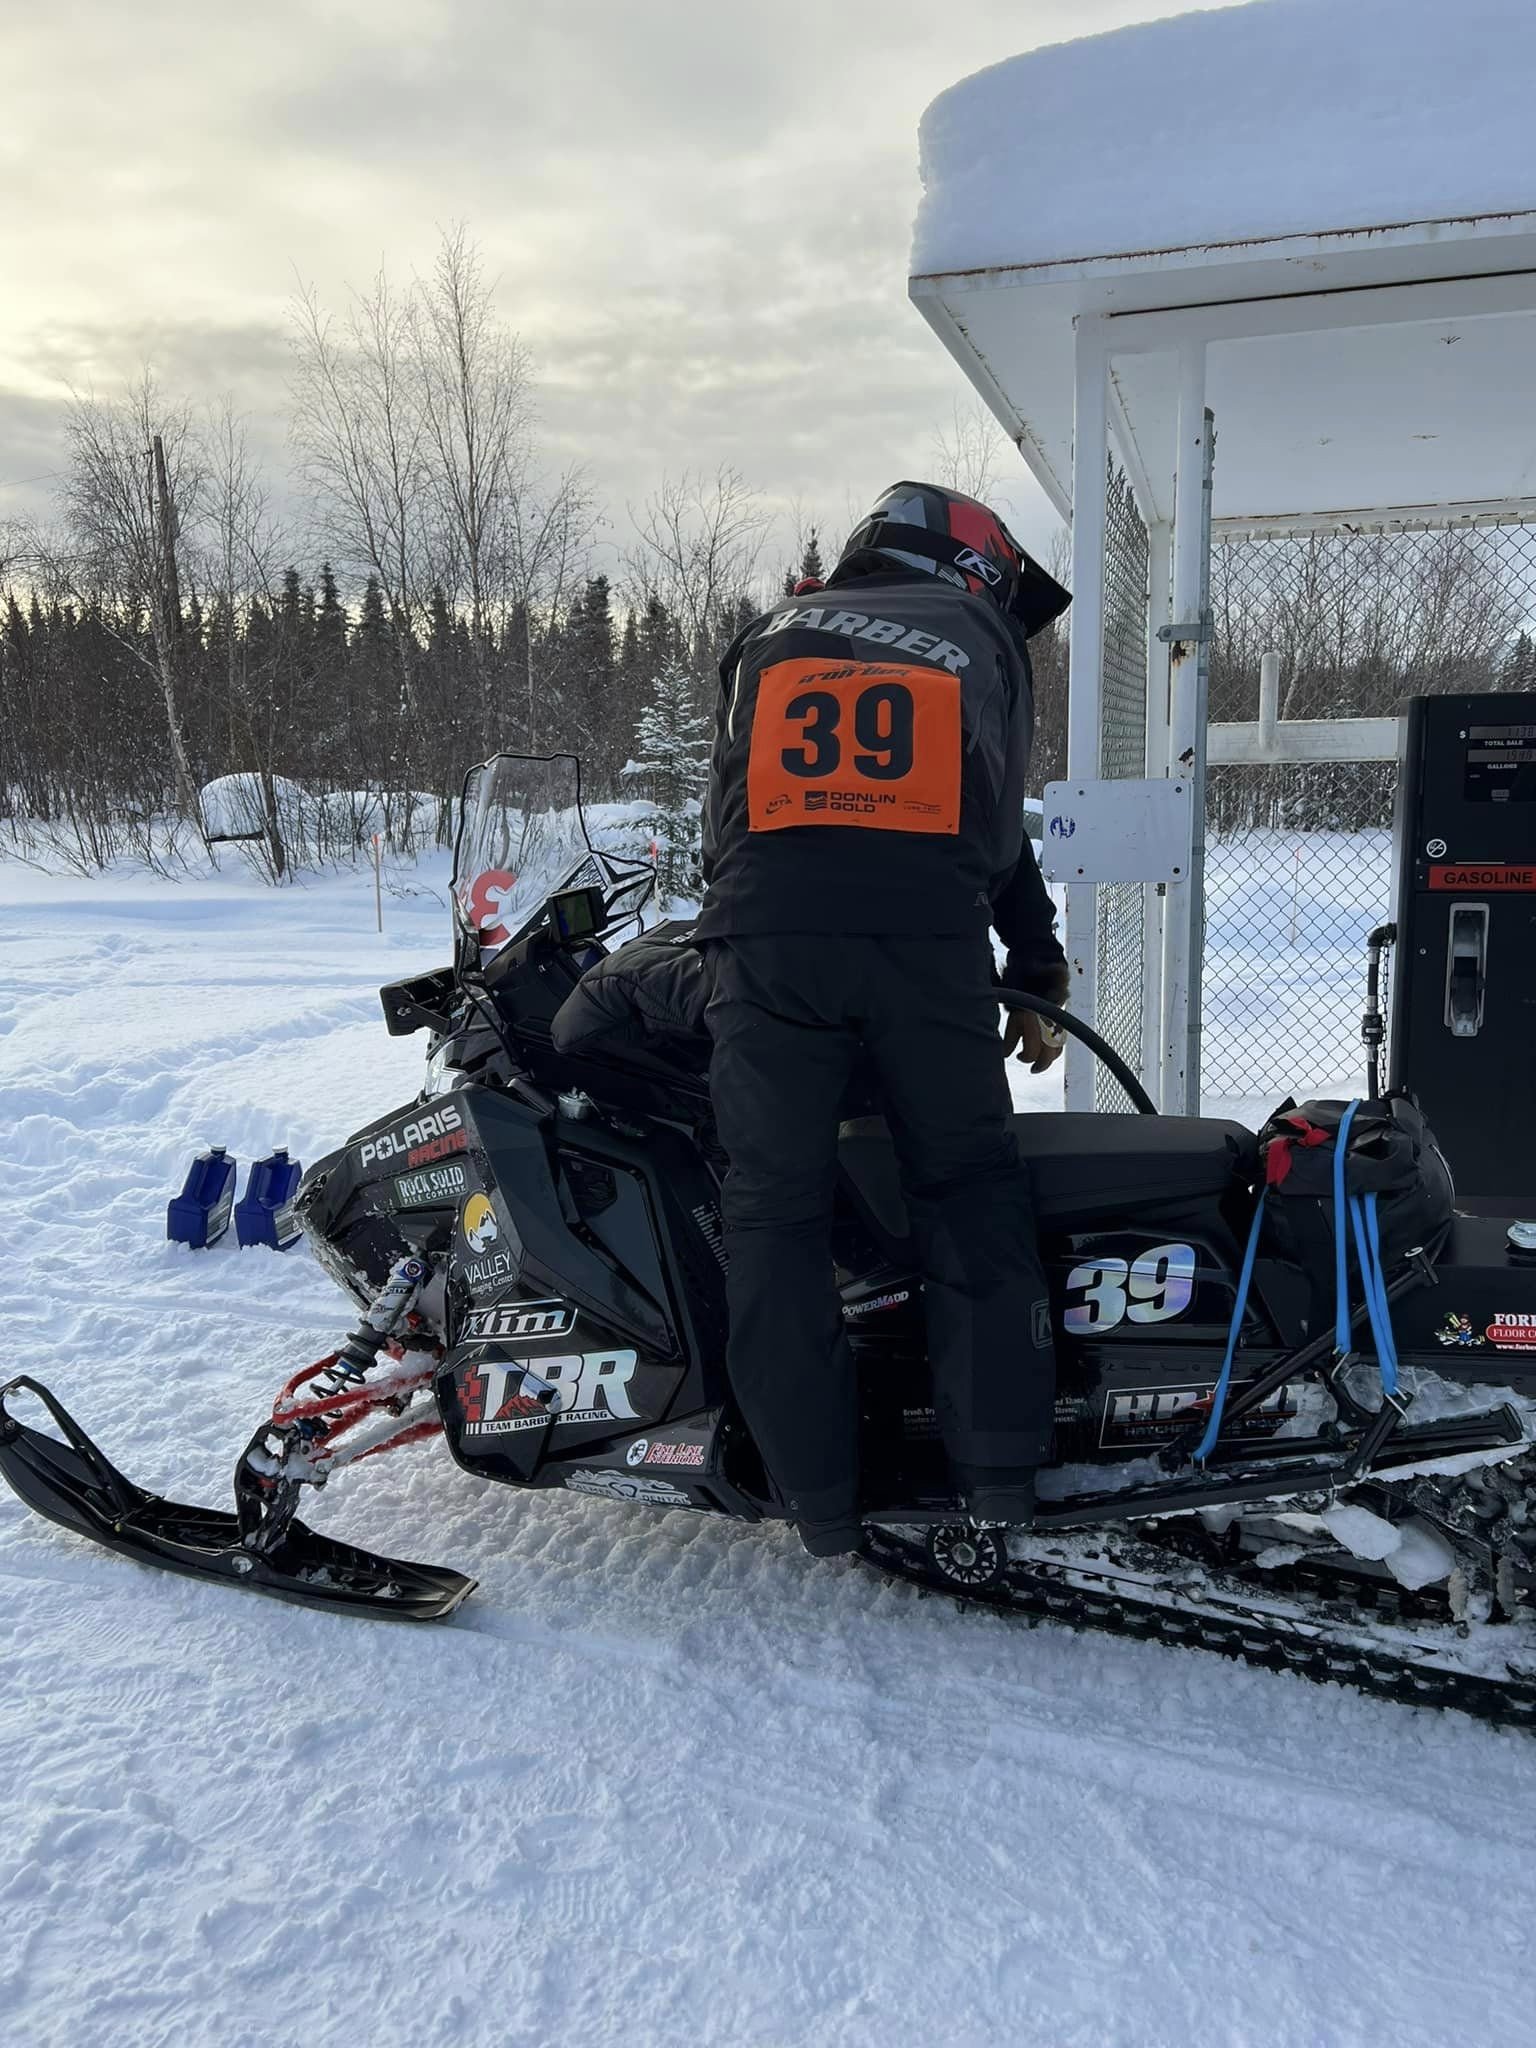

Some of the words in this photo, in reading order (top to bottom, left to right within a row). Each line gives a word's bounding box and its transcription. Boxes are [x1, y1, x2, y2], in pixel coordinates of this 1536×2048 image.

[755, 607, 970, 675] BARBER
[780, 682, 915, 781] 39
[829, 791, 897, 804] DONLIN
[829, 801, 876, 813] GOLD
[1443, 871, 1533, 885] GASOLINE
[360, 1104, 463, 1169] POLARIS
[407, 1128, 467, 1169] RACING
[398, 1173, 432, 1199] ROCK
[430, 1166, 465, 1191] SOLID
[425, 1185, 467, 1200] COMPANY
[464, 1250, 511, 1284] VALLEY
[1063, 1243, 1196, 1335] 39
[1493, 1328, 1526, 1338] FLOOR
[476, 1349, 642, 1421] TBR
[484, 1422, 511, 1432] TEAM
[566, 1410, 608, 1421] RACING
